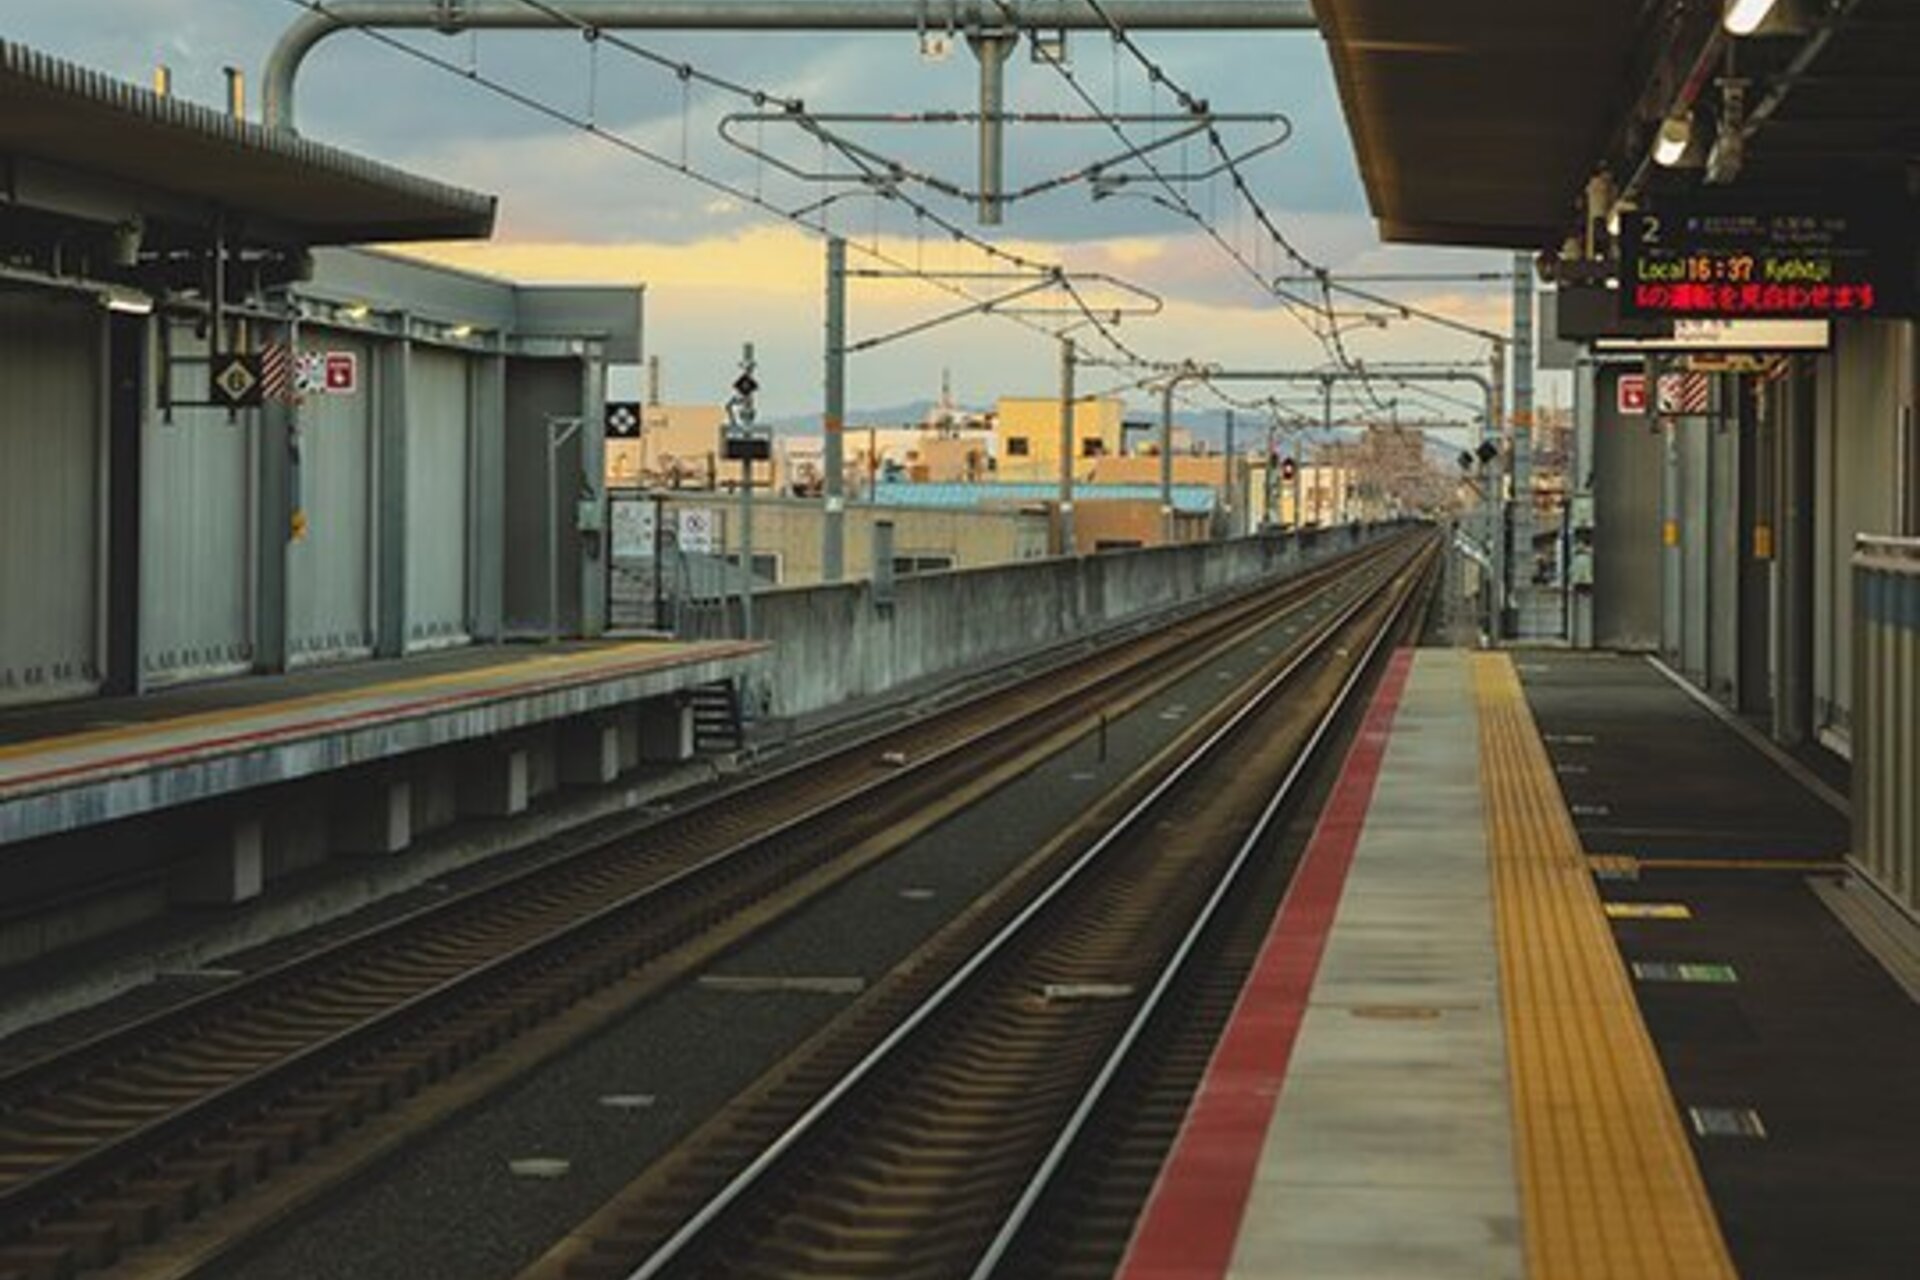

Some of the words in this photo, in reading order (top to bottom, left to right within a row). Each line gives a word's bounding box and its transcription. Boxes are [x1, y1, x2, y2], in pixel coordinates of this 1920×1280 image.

[1641, 216, 1660, 242] 2
[1637, 258, 1685, 280] Local
[1688, 256, 1753, 280] 16:37
